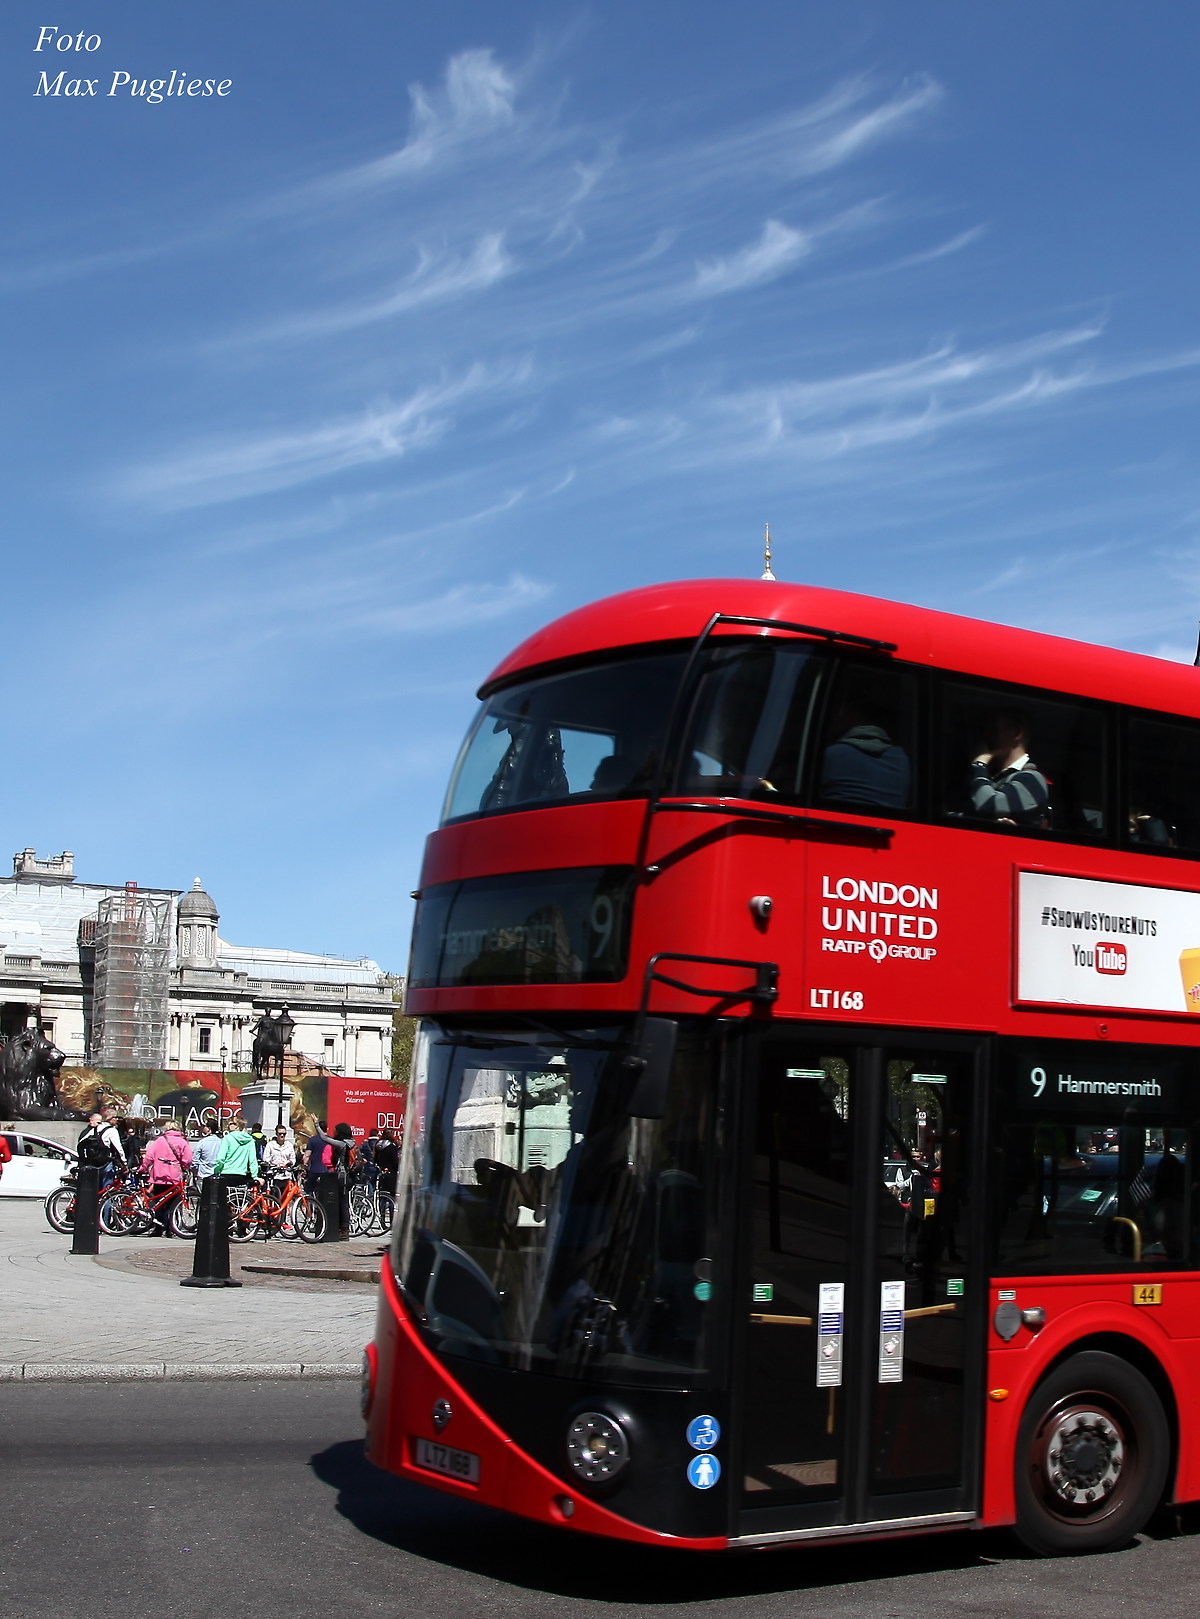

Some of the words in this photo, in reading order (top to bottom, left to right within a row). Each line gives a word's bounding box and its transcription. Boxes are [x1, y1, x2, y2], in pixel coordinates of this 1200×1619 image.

[822, 875, 938, 910] LONDON
[591, 895, 613, 958] 9
[822, 906, 938, 940] UNITED
[822, 938, 867, 954] RATP
[888, 944, 938, 961] GROUP
[810, 988, 864, 1010] LT168
[1030, 1066, 1047, 1098] 9
[1058, 1074, 1162, 1097] Hammersmith
[1140, 1287, 1155, 1303] 44
